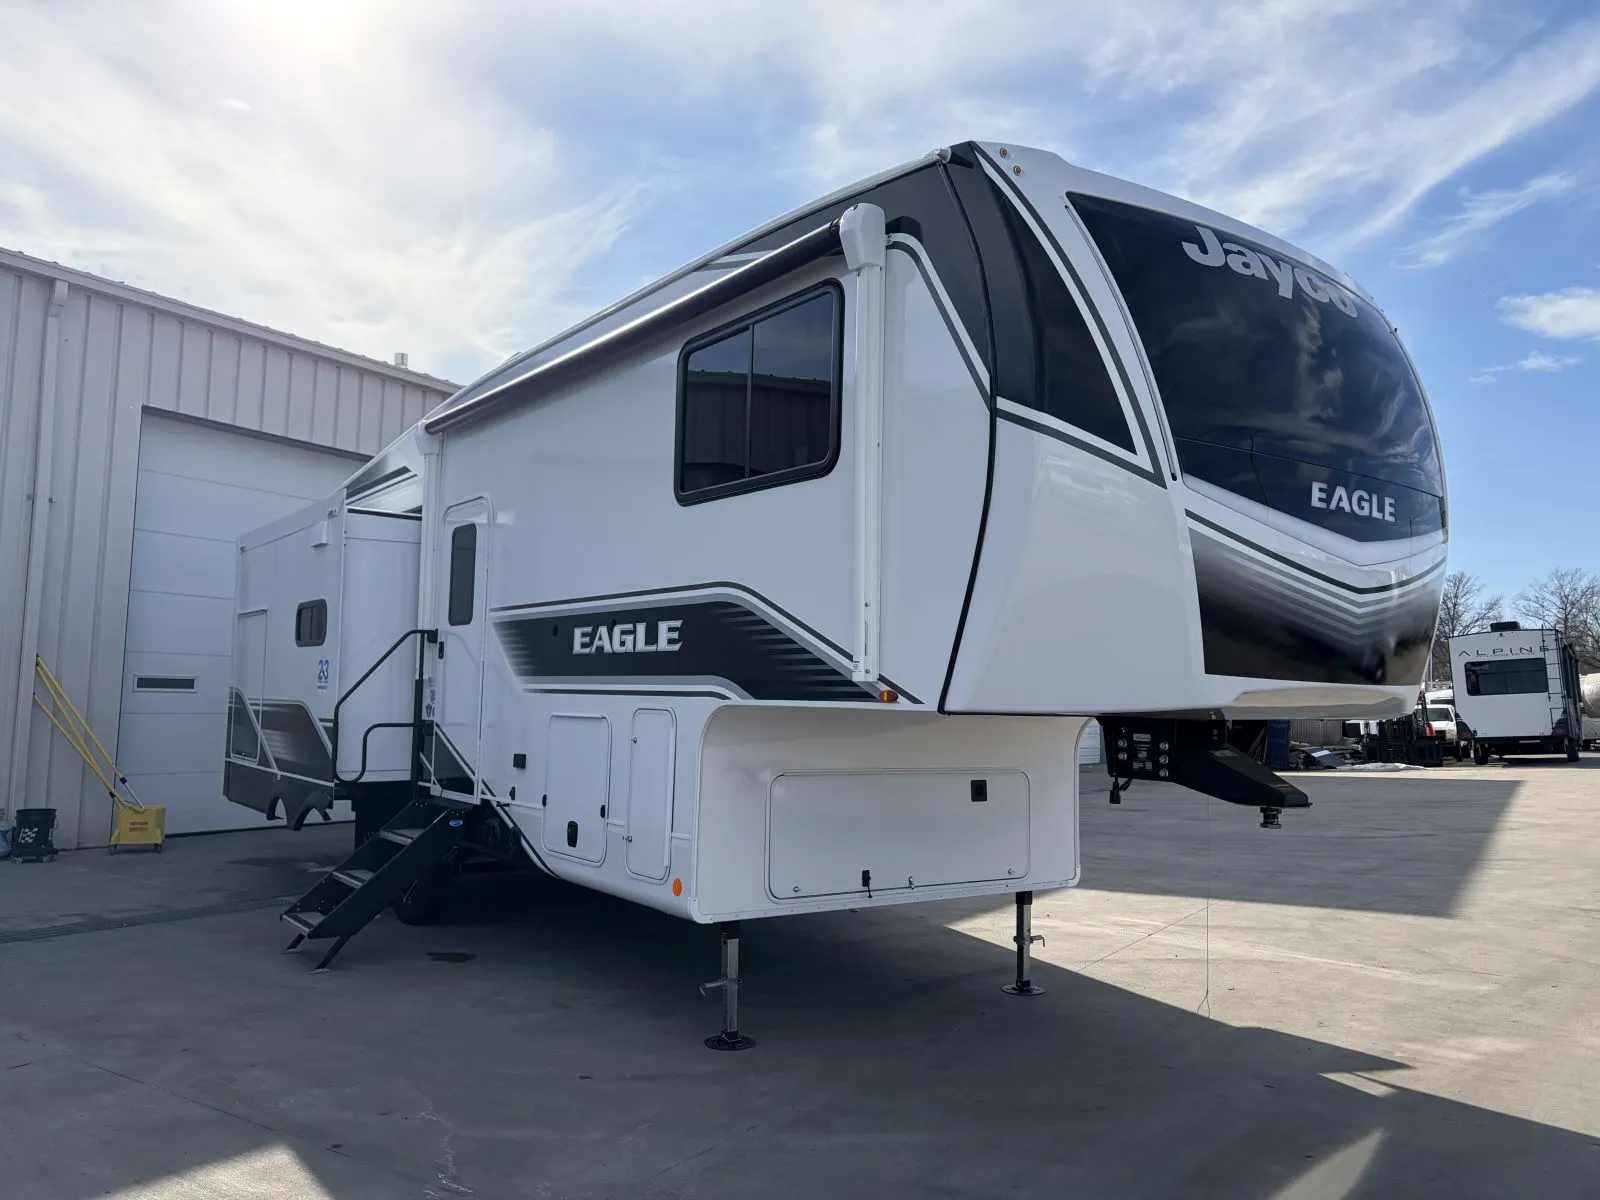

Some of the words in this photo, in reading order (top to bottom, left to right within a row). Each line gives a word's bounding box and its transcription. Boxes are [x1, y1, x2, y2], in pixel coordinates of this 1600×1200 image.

[1181, 225, 1358, 318] Jayco
[1311, 481, 1396, 522] EAGLE
[572, 620, 683, 655] EAGLE
[1458, 645, 1549, 657] ALPINE
